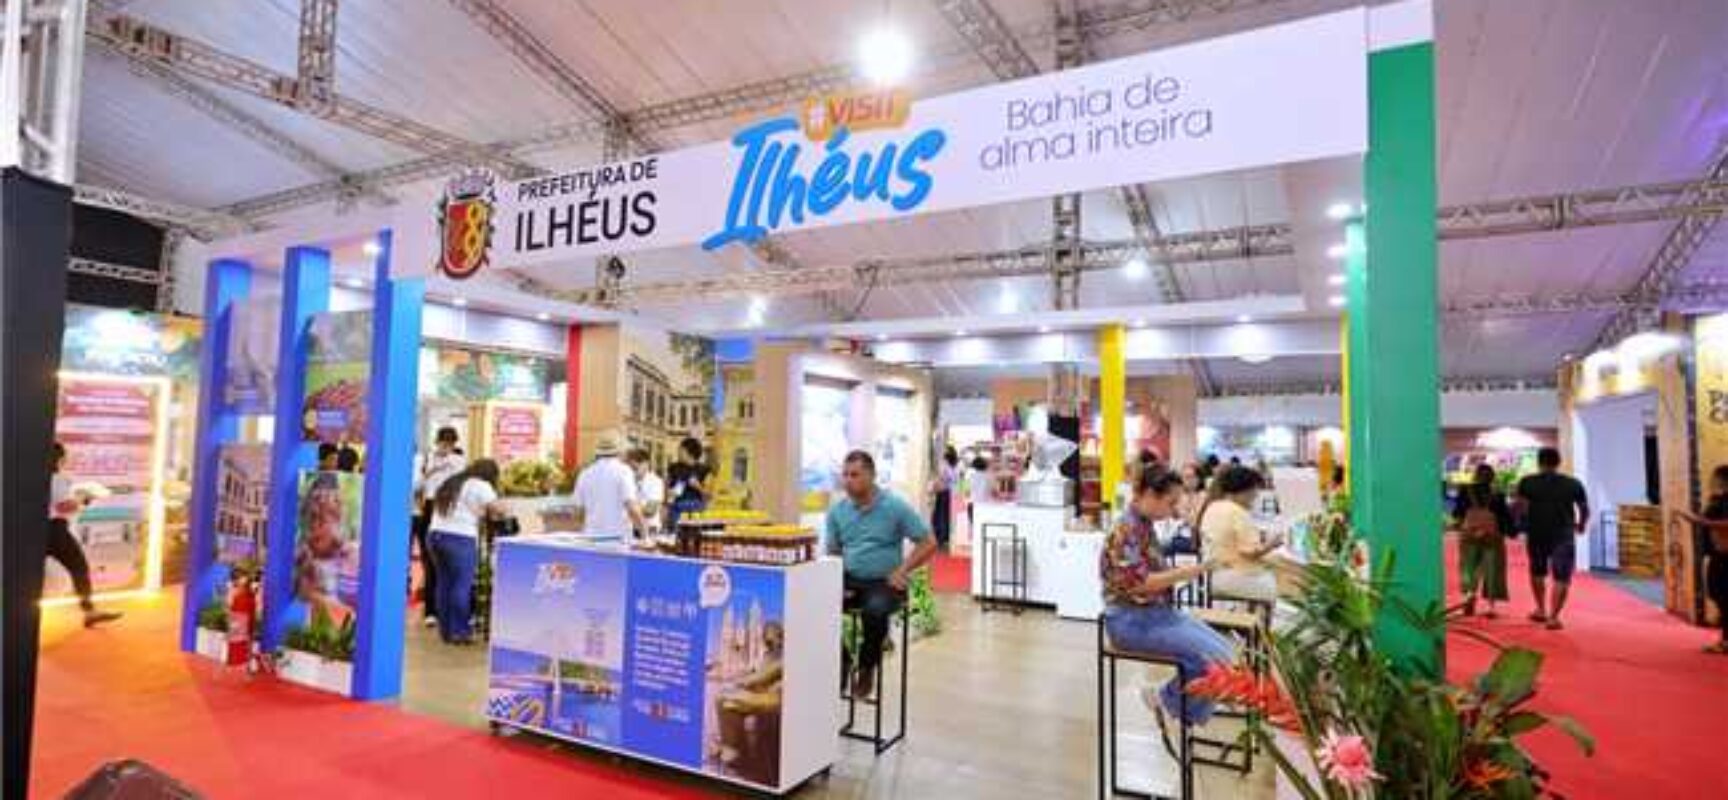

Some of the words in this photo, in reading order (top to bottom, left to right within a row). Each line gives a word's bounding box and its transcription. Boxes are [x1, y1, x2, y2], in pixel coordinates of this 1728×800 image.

[1007, 84, 1113, 132] Bahia
[1123, 75, 1181, 110] de
[979, 132, 1076, 171] alma
[1087, 109, 1214, 154] inteira
[517, 164, 626, 200] PREFEITURA
[629, 157, 659, 182] DE
[701, 116, 947, 251] Ilhéus
[515, 190, 658, 252] ILHÉUS
